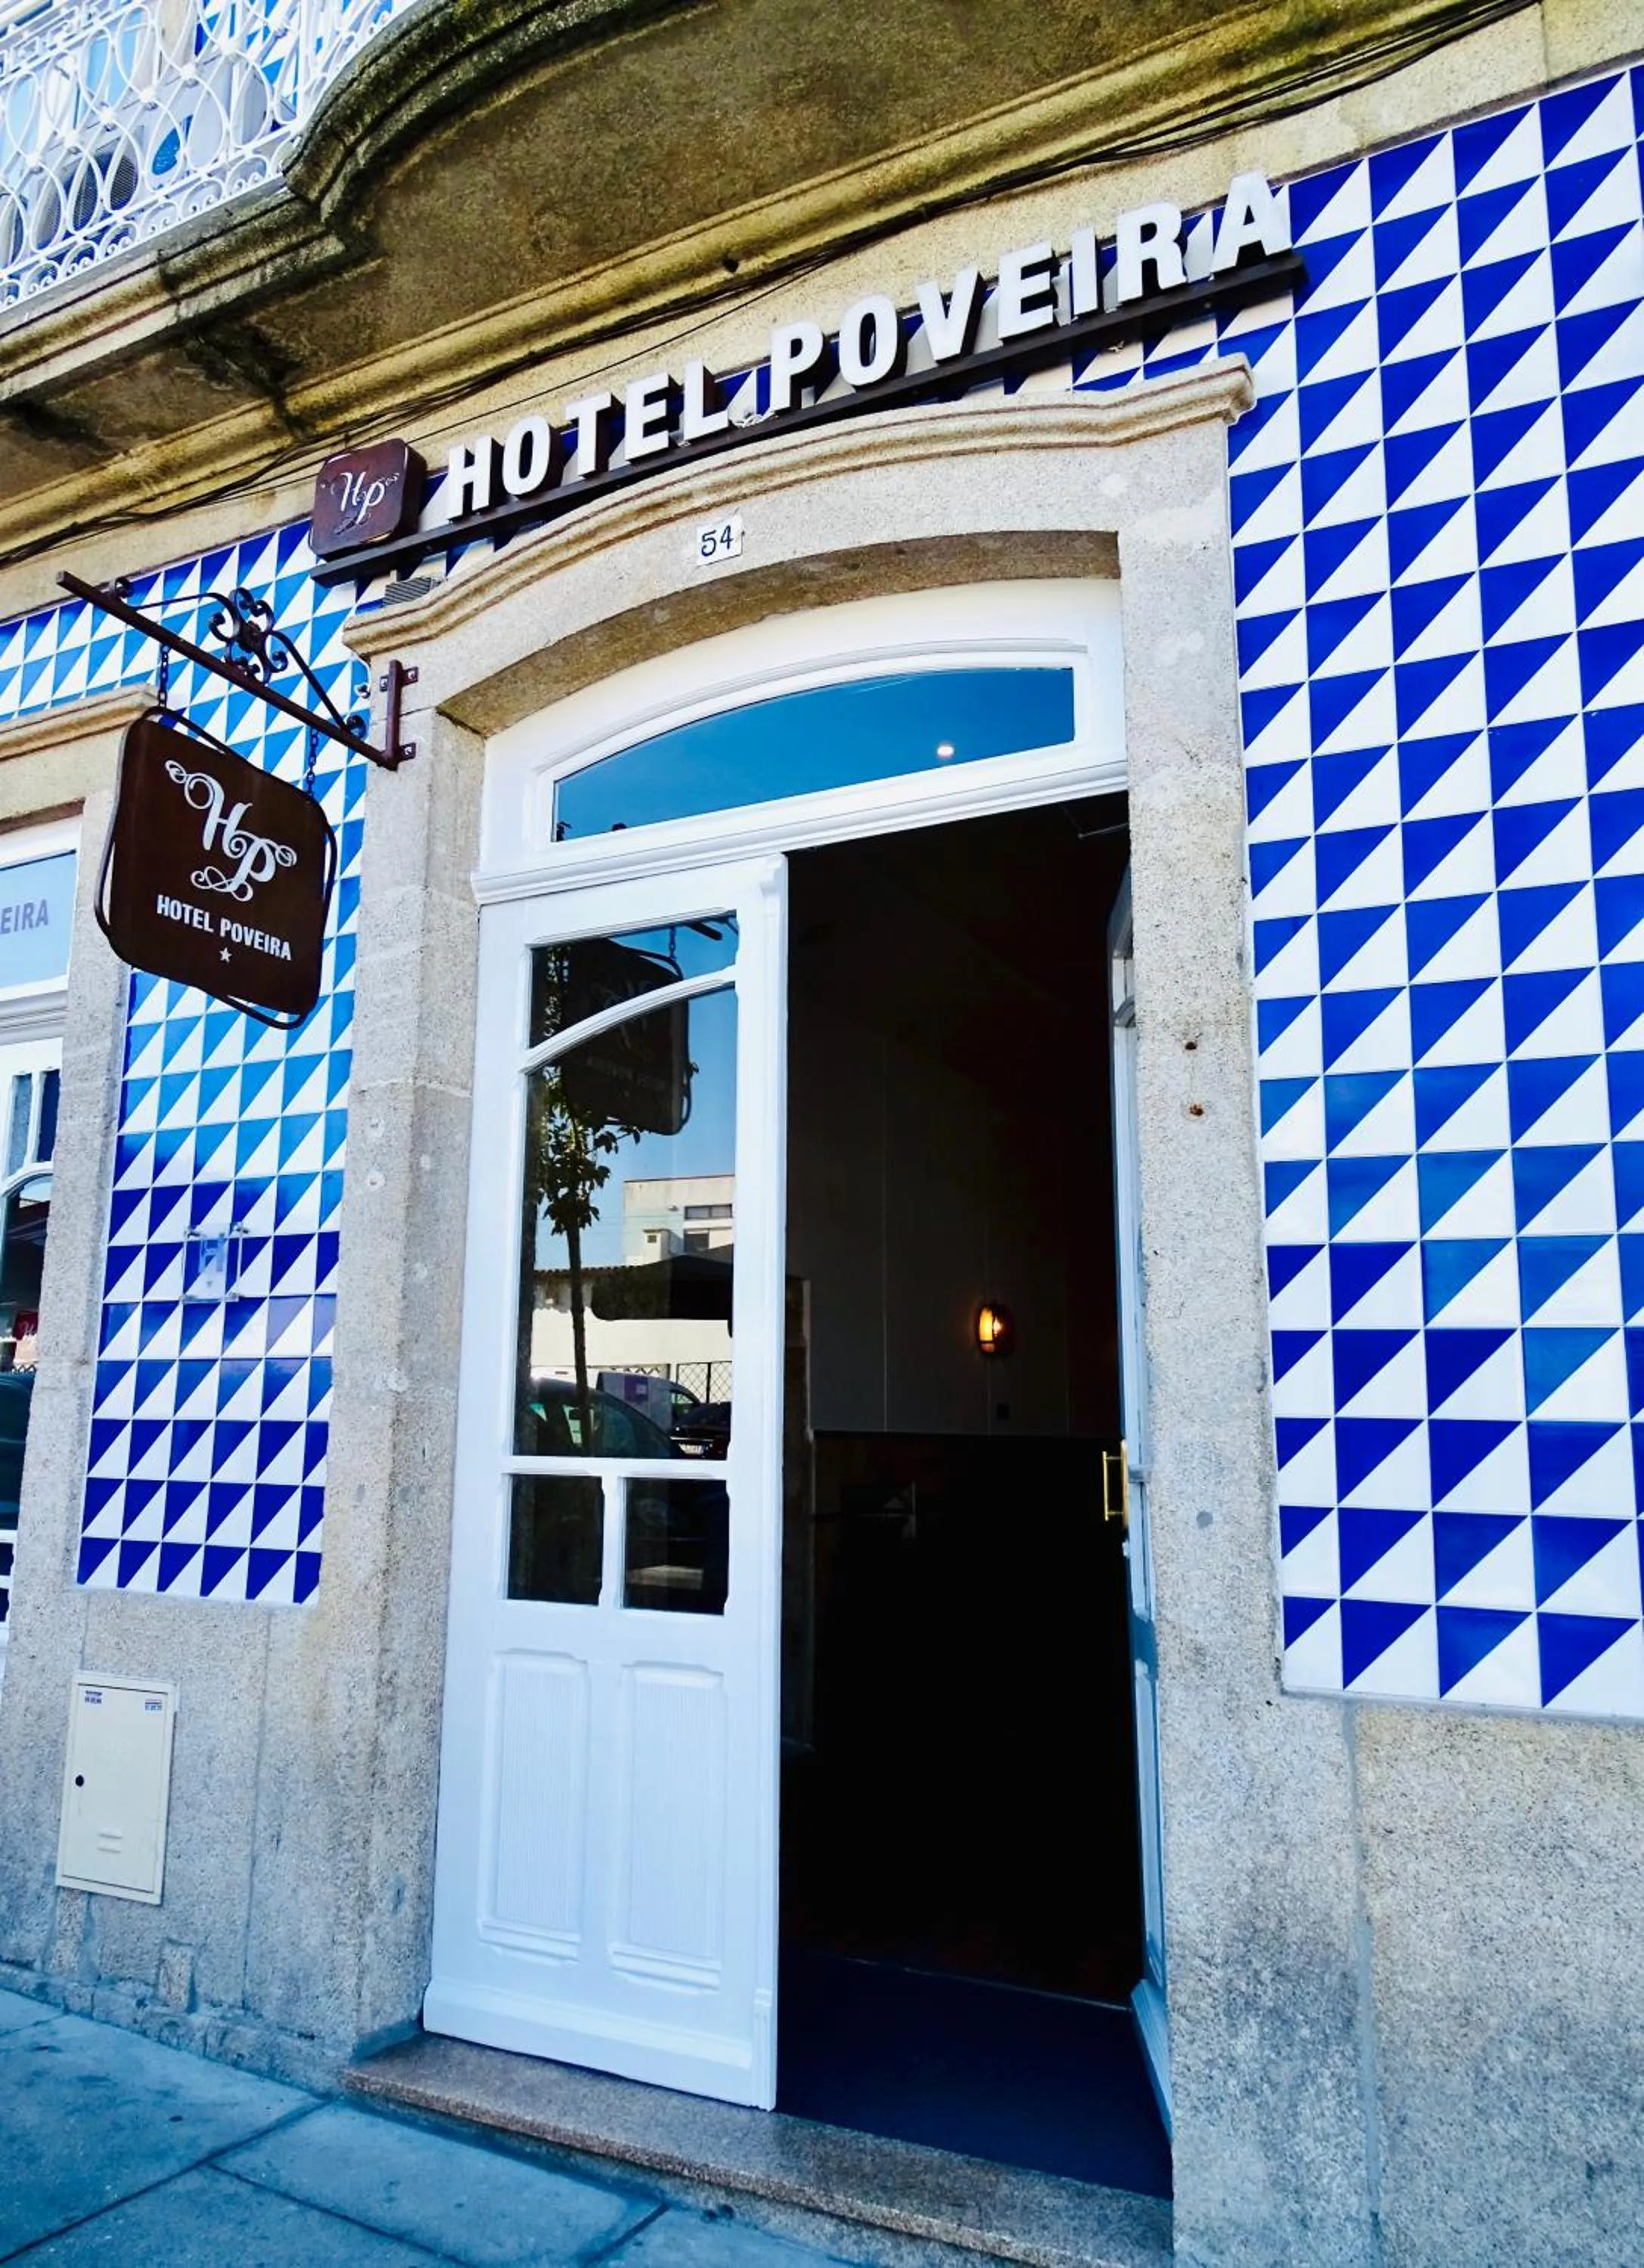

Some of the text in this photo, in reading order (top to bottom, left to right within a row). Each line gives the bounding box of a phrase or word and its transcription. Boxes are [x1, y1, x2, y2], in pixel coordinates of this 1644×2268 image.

[447, 169, 1292, 519] HOTEL POVEIRA
[701, 524, 734, 557] 54
[0, 898, 49, 935] EIRA
[157, 894, 292, 962] HOTEL POVEIRA
